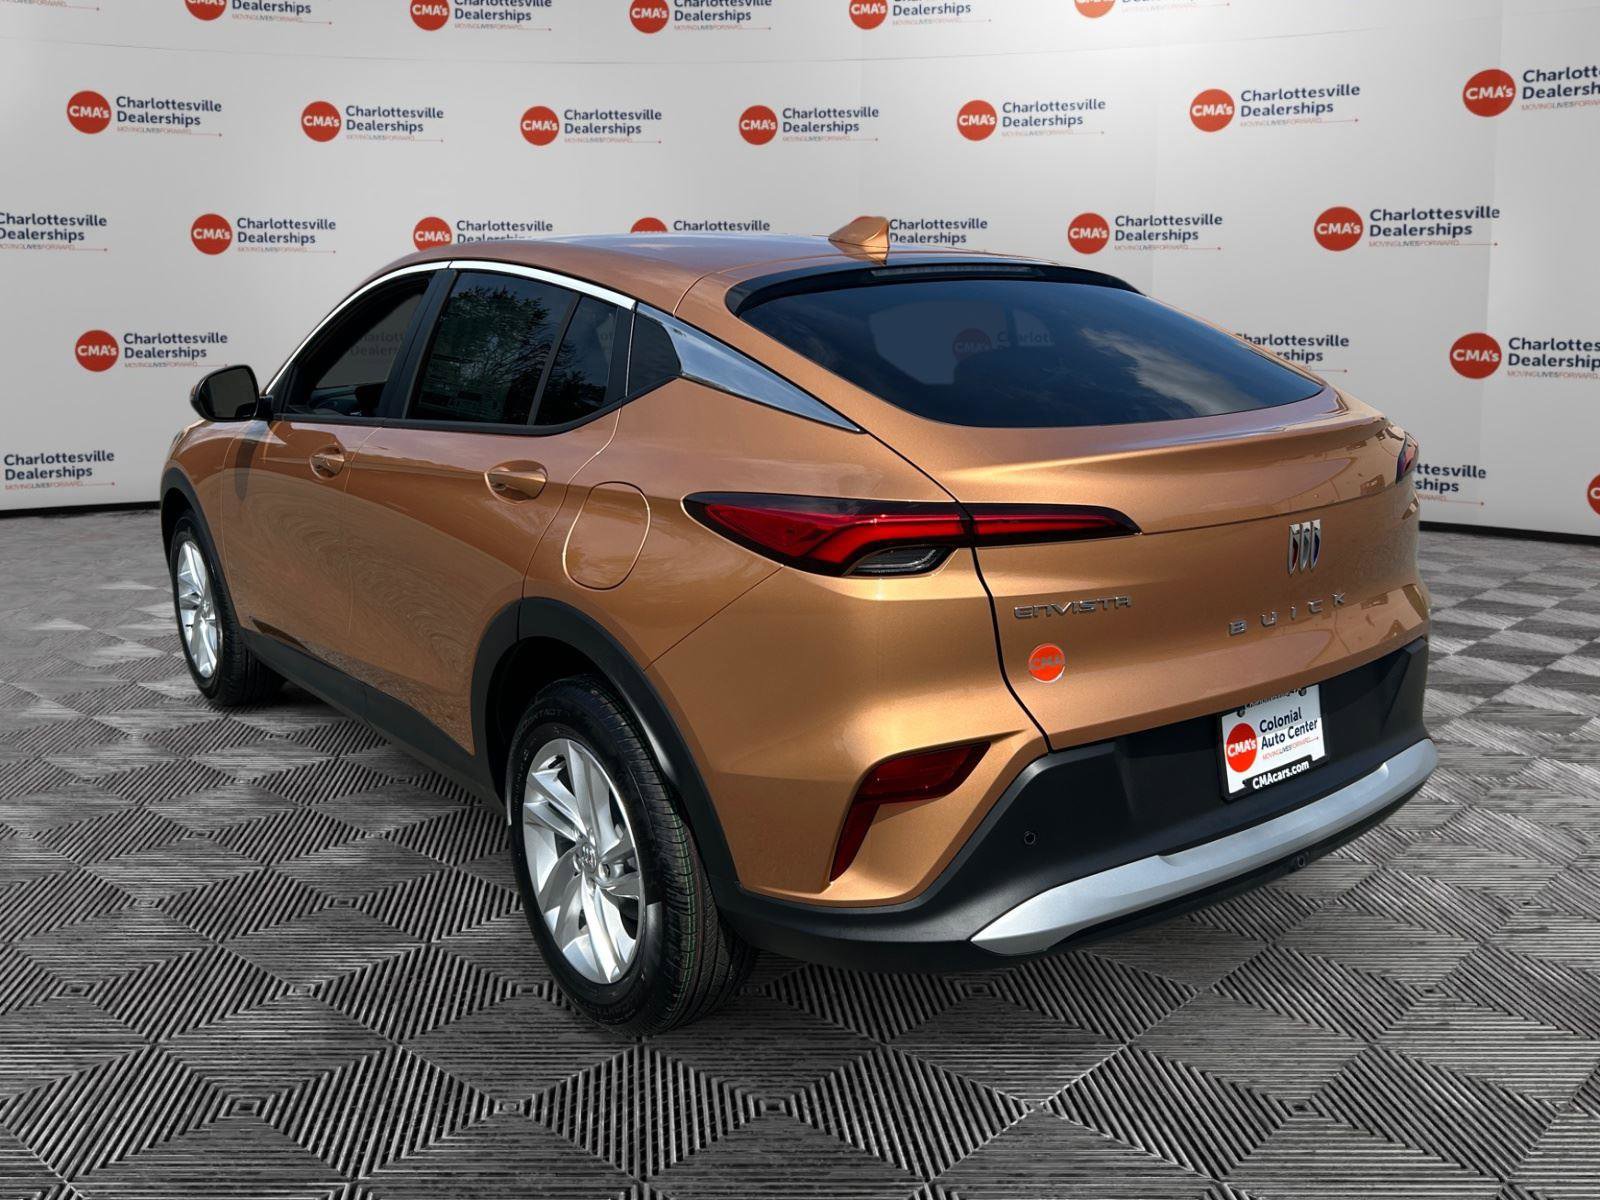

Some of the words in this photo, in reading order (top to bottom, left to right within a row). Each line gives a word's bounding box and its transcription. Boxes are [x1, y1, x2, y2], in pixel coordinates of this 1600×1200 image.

[232, 0, 311, 15] Dealerships
[412, 4, 449, 16] CMA's
[632, 8, 669, 19] CMA's
[851, 3, 886, 16] CMA's
[893, 3, 972, 16] Dealerships
[454, 8, 532, 23] Dealerships
[674, 10, 752, 23] Dealerships
[1522, 66, 1600, 84] Charlott
[1240, 84, 1360, 102] Charlottesville
[1465, 85, 1514, 100] CMA's
[1522, 82, 1600, 100] Dealersh
[116, 96, 222, 112] Charlottesville
[1002, 98, 1106, 113] Charlottesville
[1190, 103, 1233, 118] CMA's
[1240, 101, 1334, 117] Dealerships
[69, 105, 110, 119] CMA's
[346, 104, 444, 119] Charlottesville
[564, 109, 662, 121] Charlottesville
[782, 106, 879, 119] Charlottesville
[117, 110, 201, 128] Dealerships
[303, 115, 340, 128] CMA's
[522, 120, 558, 132] CMA's
[740, 119, 776, 131] CMA's
[958, 114, 996, 126] CMA's
[1002, 114, 1083, 128] Dealerships
[346, 119, 424, 134] Dealerships
[564, 122, 642, 136] Dealerships
[782, 121, 859, 134] Dealerships
[1115, 214, 1223, 227] Charlottesville
[1369, 206, 1500, 222] Charlottesville
[237, 217, 336, 230] Charlottesville
[456, 220, 553, 232] Charlottesville
[673, 220, 770, 231] Charlottesville
[889, 218, 988, 230] Charlottesville
[1316, 222, 1361, 236] CMA's
[1370, 222, 1472, 238] Dealerships
[0, 228, 85, 244] Dealerships
[193, 228, 231, 240] CMA's
[238, 231, 316, 246] Dealerships
[414, 230, 450, 242] CMA's
[890, 232, 966, 245] Dealerships
[1070, 227, 1108, 239] CMA's
[1115, 229, 1199, 243] Dealerships
[123, 332, 228, 345] Charlottesville
[1236, 333, 1349, 347] harlottesville
[1508, 337, 1600, 352] Charlottes
[77, 345, 117, 357] CMA's
[124, 347, 207, 360] Dealerships
[1452, 349, 1500, 362] CMA's
[1508, 353, 1600, 371] Dealership
[4, 450, 114, 466] Charlottesville
[5, 466, 93, 481] Dealerships
[1416, 463, 1486, 479] ttesville
[1014, 596, 1132, 619] ENVISTA
[1229, 592, 1346, 636] BUICK
[1259, 706, 1302, 733] Colonial
[1261, 732, 1286, 750] Auto
[1288, 720, 1318, 740] Center
[1228, 738, 1257, 758] CMA's
[1252, 760, 1310, 789] CMAcars.com
